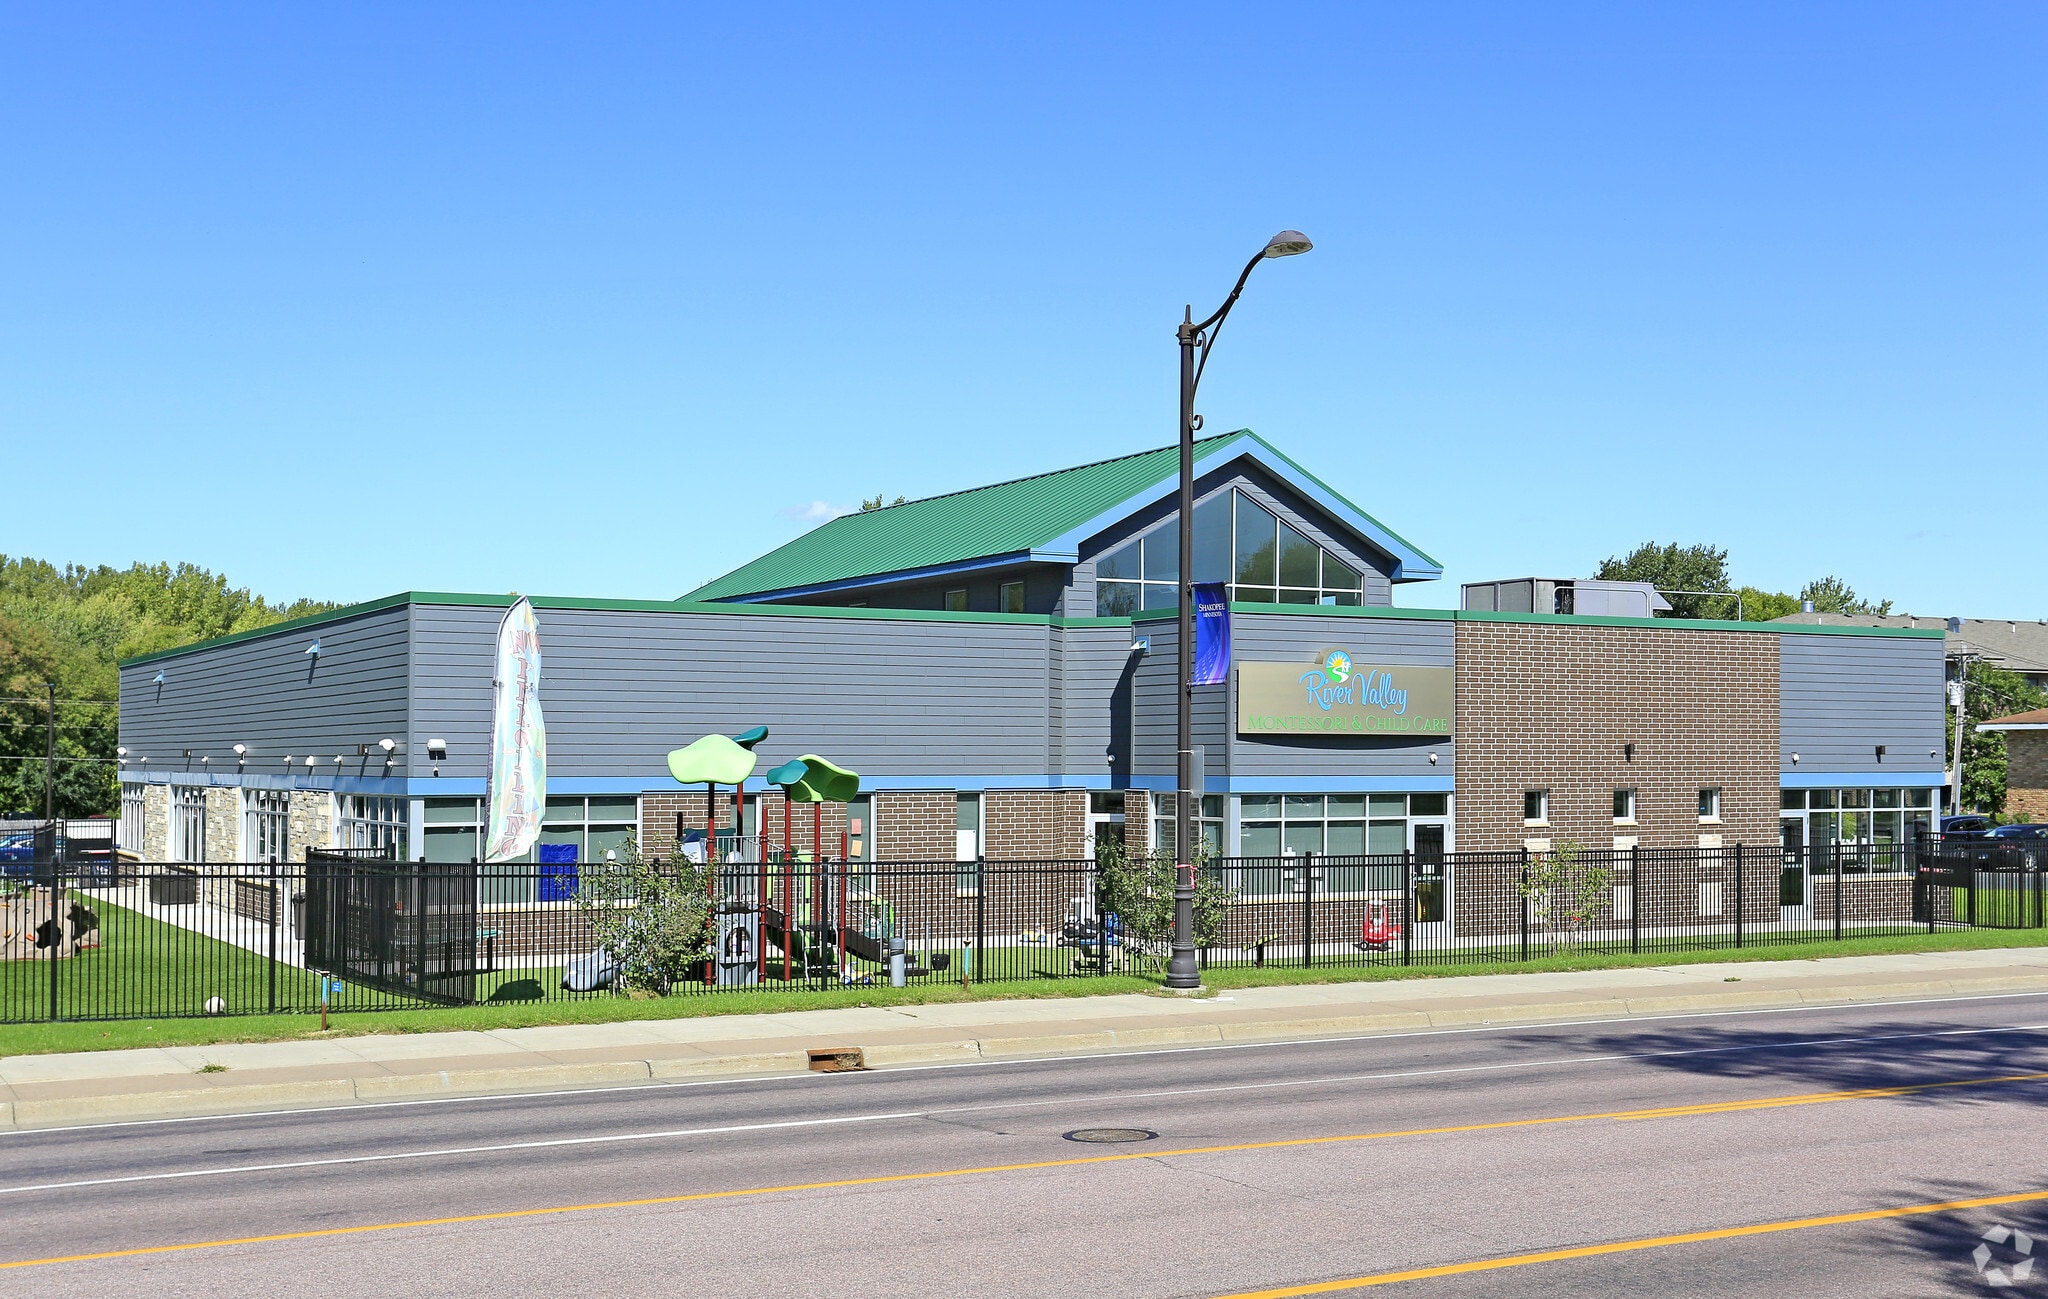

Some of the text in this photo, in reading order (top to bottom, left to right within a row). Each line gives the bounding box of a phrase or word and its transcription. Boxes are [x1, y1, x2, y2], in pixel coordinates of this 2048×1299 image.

[1198, 603, 1226, 612] SHAKOPEE
[510, 630, 541, 655] NW
[1298, 669, 1408, 716] River Valley
[1247, 714, 1448, 733] MONTESSORI & CHILD CARE
